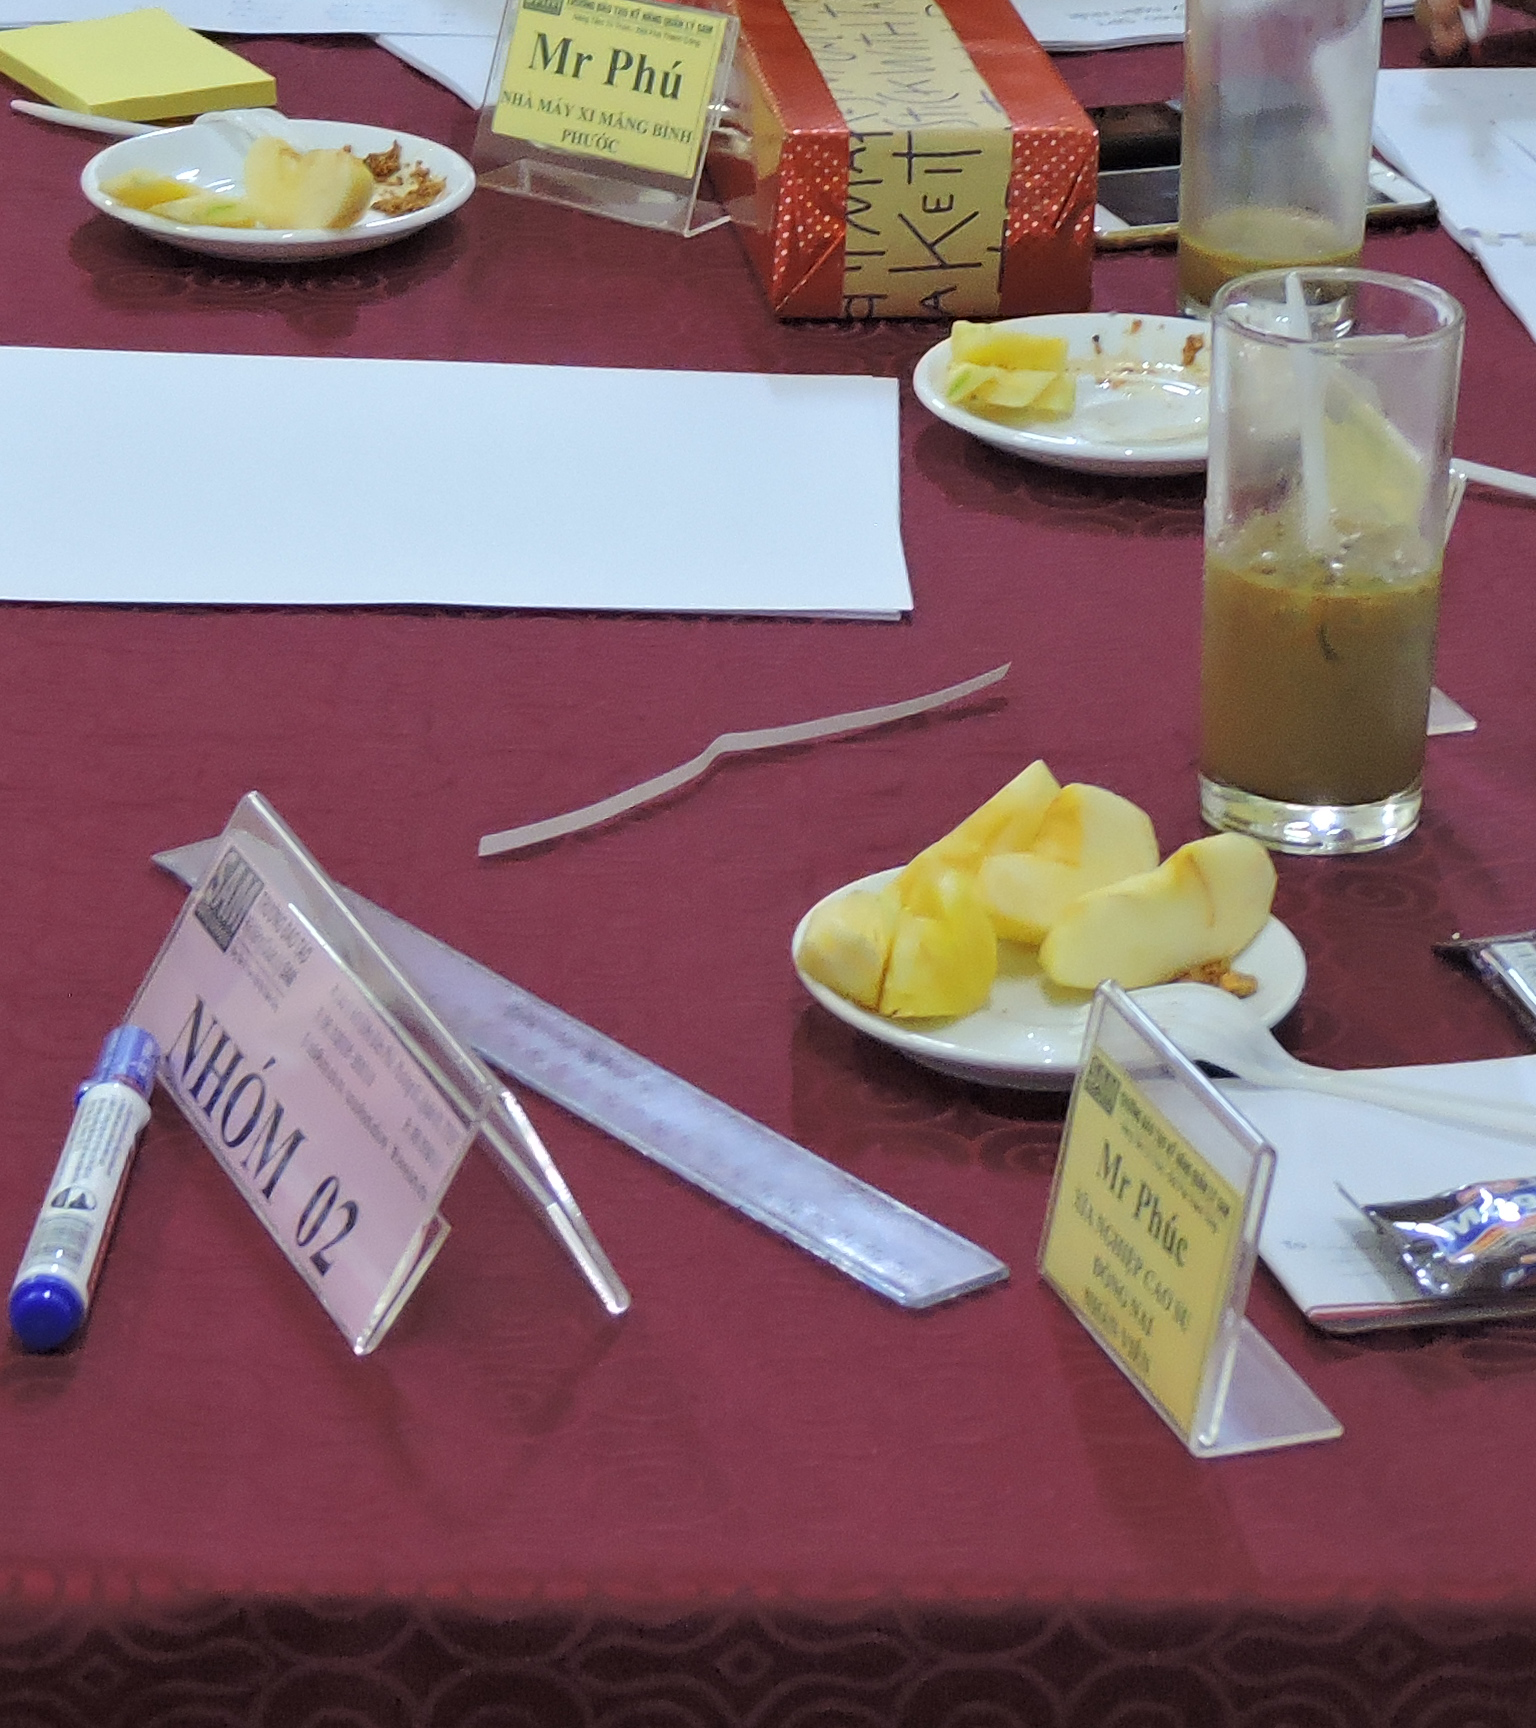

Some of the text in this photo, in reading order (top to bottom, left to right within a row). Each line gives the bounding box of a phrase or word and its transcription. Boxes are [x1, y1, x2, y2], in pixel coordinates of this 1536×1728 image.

[501, 89, 533, 110] NHÀ
[537, 96, 575, 118] MÁY
[577, 106, 596, 122] XI
[528, 32, 683, 101] Mr Phú
[162, 996, 309, 1202] NHÓM
[293, 1174, 360, 1278] 02
[1095, 1137, 1134, 1204] Mr
[1133, 1181, 1189, 1269] Phúc
